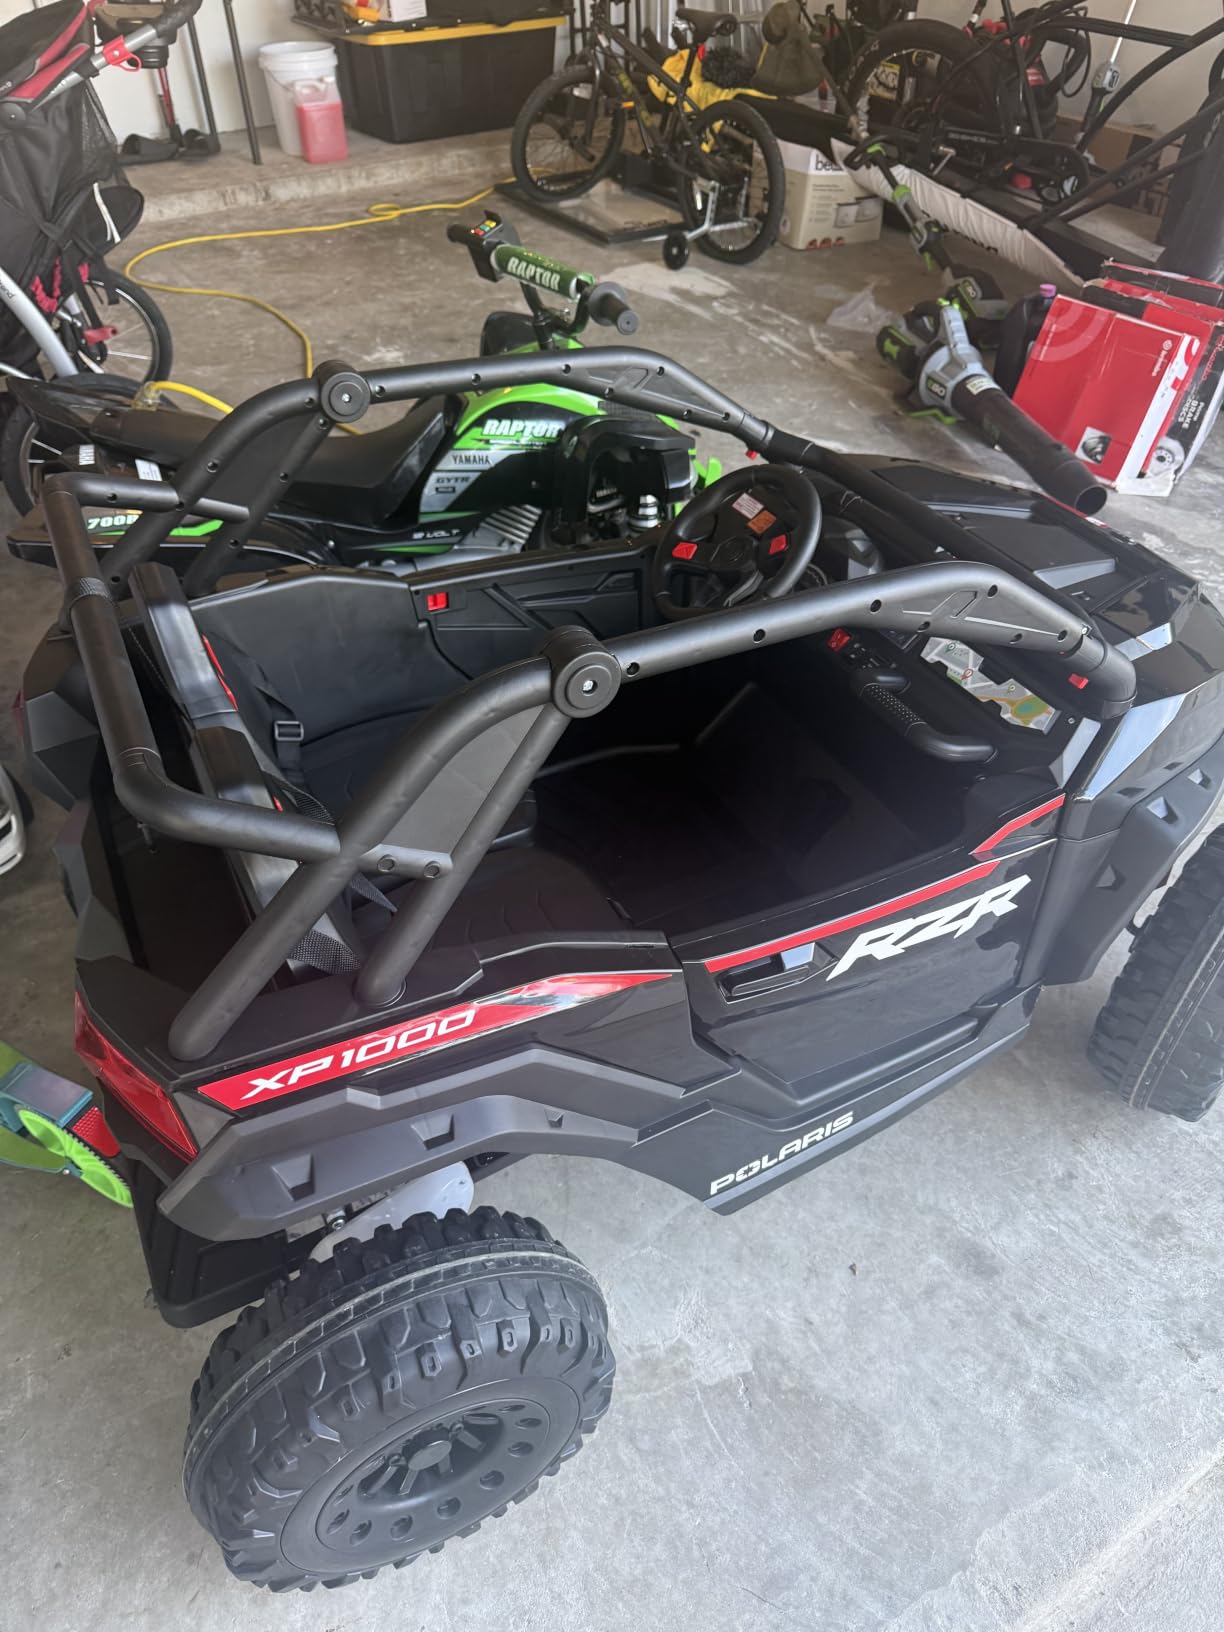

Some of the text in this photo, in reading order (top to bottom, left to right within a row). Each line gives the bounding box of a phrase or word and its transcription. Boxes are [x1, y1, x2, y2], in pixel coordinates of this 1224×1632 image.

[507, 256, 560, 291] RAPTOR
[482, 418, 566, 439] RAPTOR
[1181, 399, 1199, 430] BRAKE
[453, 455, 491, 465] YAMAHA
[825, 874, 1033, 982] RZR
[709, 1110, 855, 1195] POLARIS
